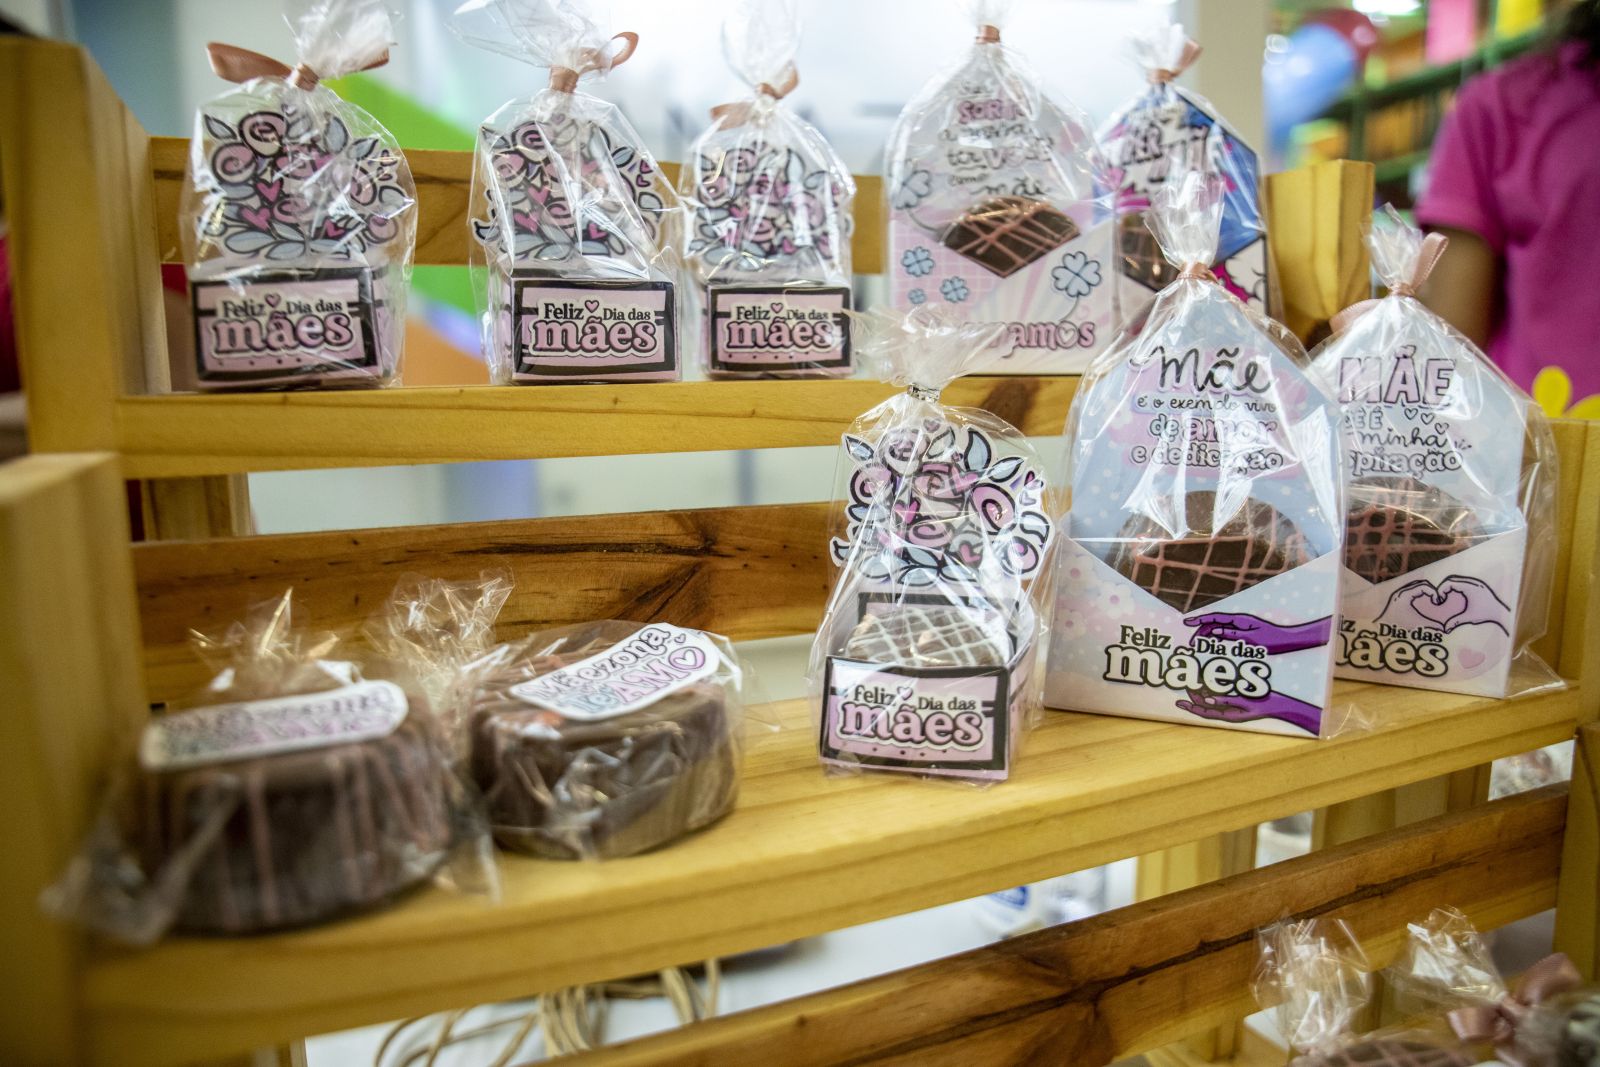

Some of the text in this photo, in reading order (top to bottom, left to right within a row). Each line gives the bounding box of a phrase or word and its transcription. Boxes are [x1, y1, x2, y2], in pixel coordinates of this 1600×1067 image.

[222, 300, 342, 318] Feliz Dia das
[543, 302, 651, 321] Feliz Dia das
[736, 306, 828, 320] Feliz Dia das
[213, 309, 354, 353] mães
[532, 315, 657, 353] mães
[726, 316, 834, 349] mães
[1129, 345, 1272, 393] Mãe
[1338, 344, 1456, 405] MÃE
[1245, 402, 1277, 413] vivo
[1150, 413, 1180, 438] de
[1354, 427, 1448, 449] minha
[1131, 445, 1147, 463] e
[1120, 625, 1266, 660] Feliz Dia das
[1379, 623, 1444, 643] Dia das
[1102, 644, 1273, 699] mães
[918, 696, 944, 711] Dia
[947, 697, 977, 711] das
[840, 701, 984, 747] mães
